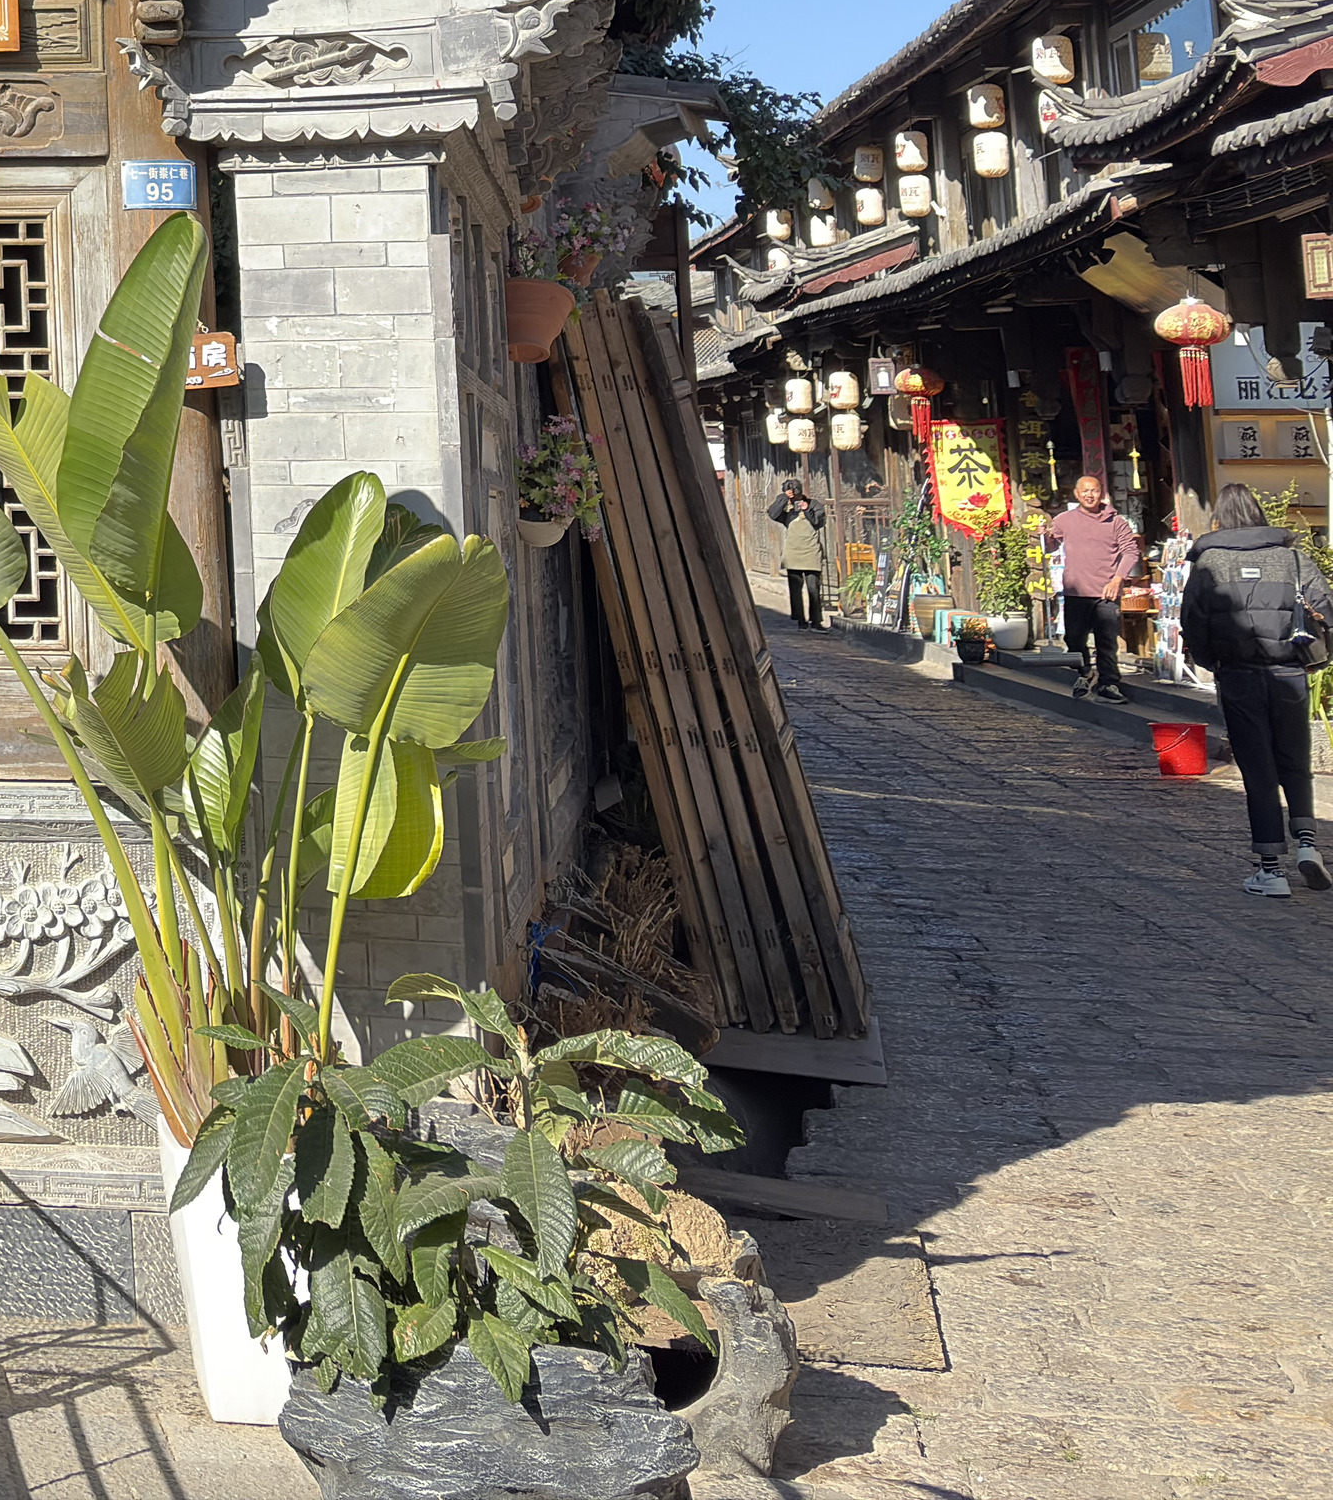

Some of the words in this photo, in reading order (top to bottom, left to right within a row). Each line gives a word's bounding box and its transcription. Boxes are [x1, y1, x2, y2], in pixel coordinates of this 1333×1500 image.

[129, 167, 189, 180] 七一街崇仁巷
[146, 182, 175, 201] 95
[947, 443, 991, 490] 茶
